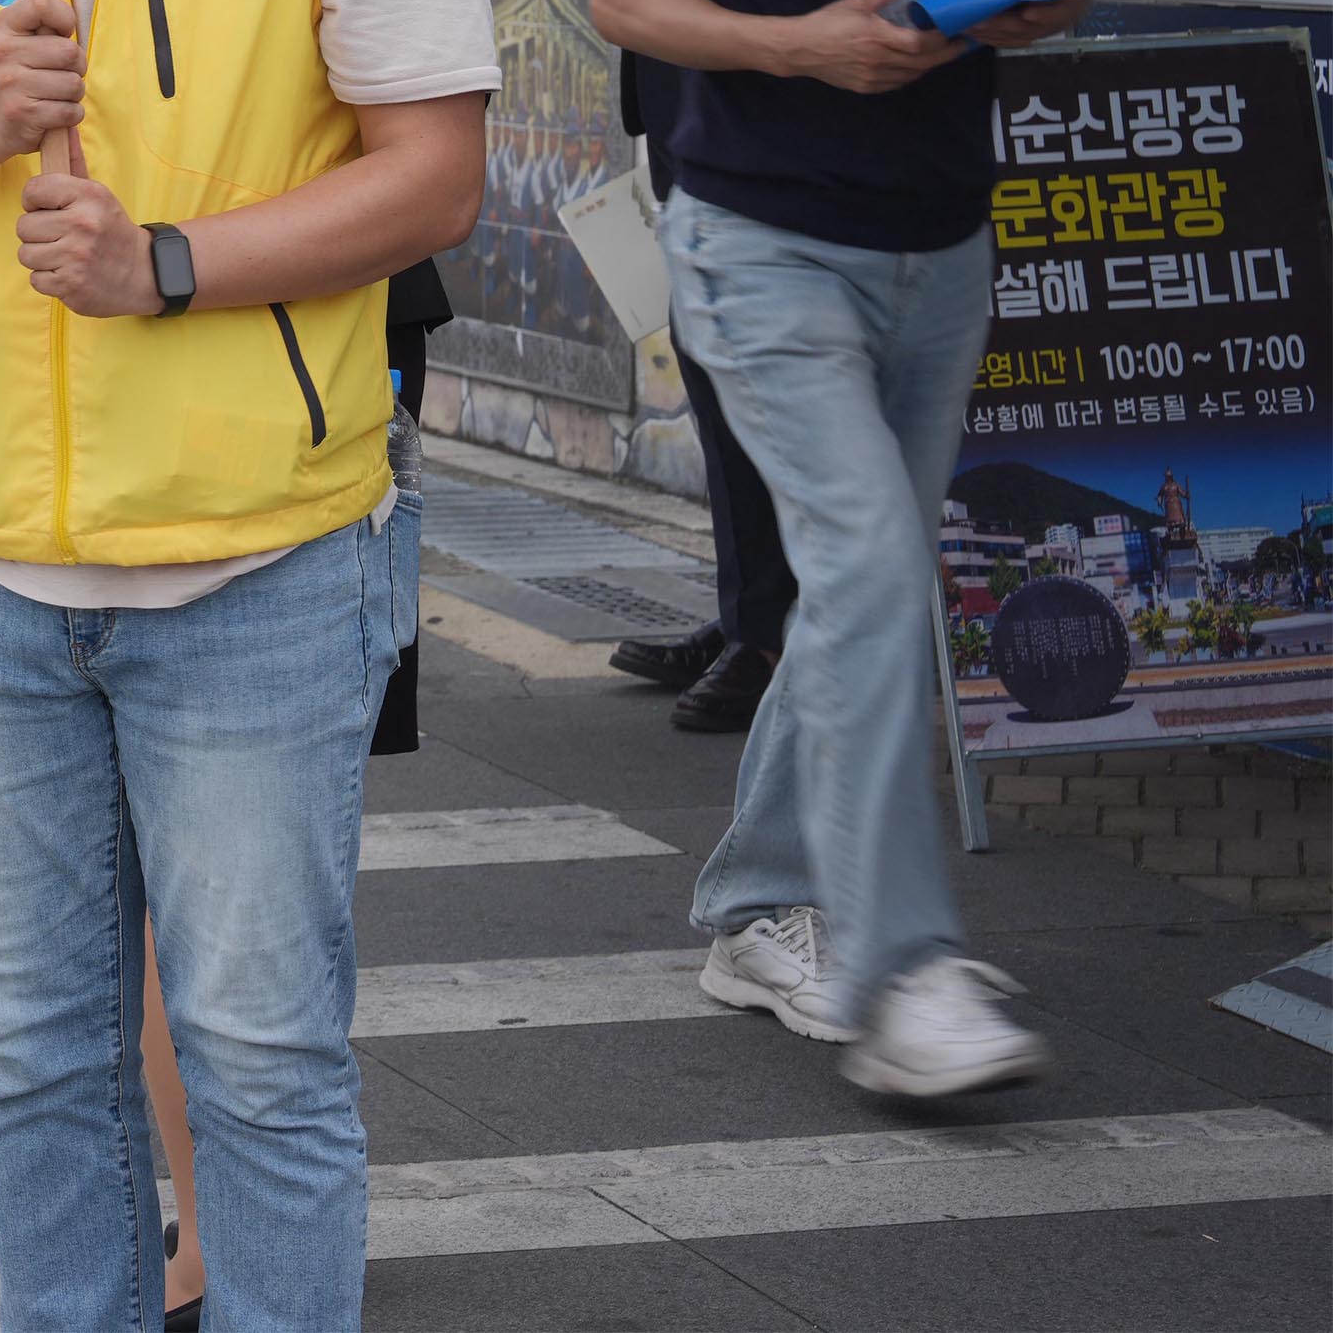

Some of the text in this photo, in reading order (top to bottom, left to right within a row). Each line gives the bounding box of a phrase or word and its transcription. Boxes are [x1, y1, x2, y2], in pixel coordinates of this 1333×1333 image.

[991, 168, 1227, 249] 문화관광
[988, 248, 1293, 319] 설해 드립니다
[1100, 341, 1183, 380] 10:00
[1220, 334, 1306, 373] 17:00
[963, 385, 1315, 434] (상황에 따라 변동될 수도 있음)
